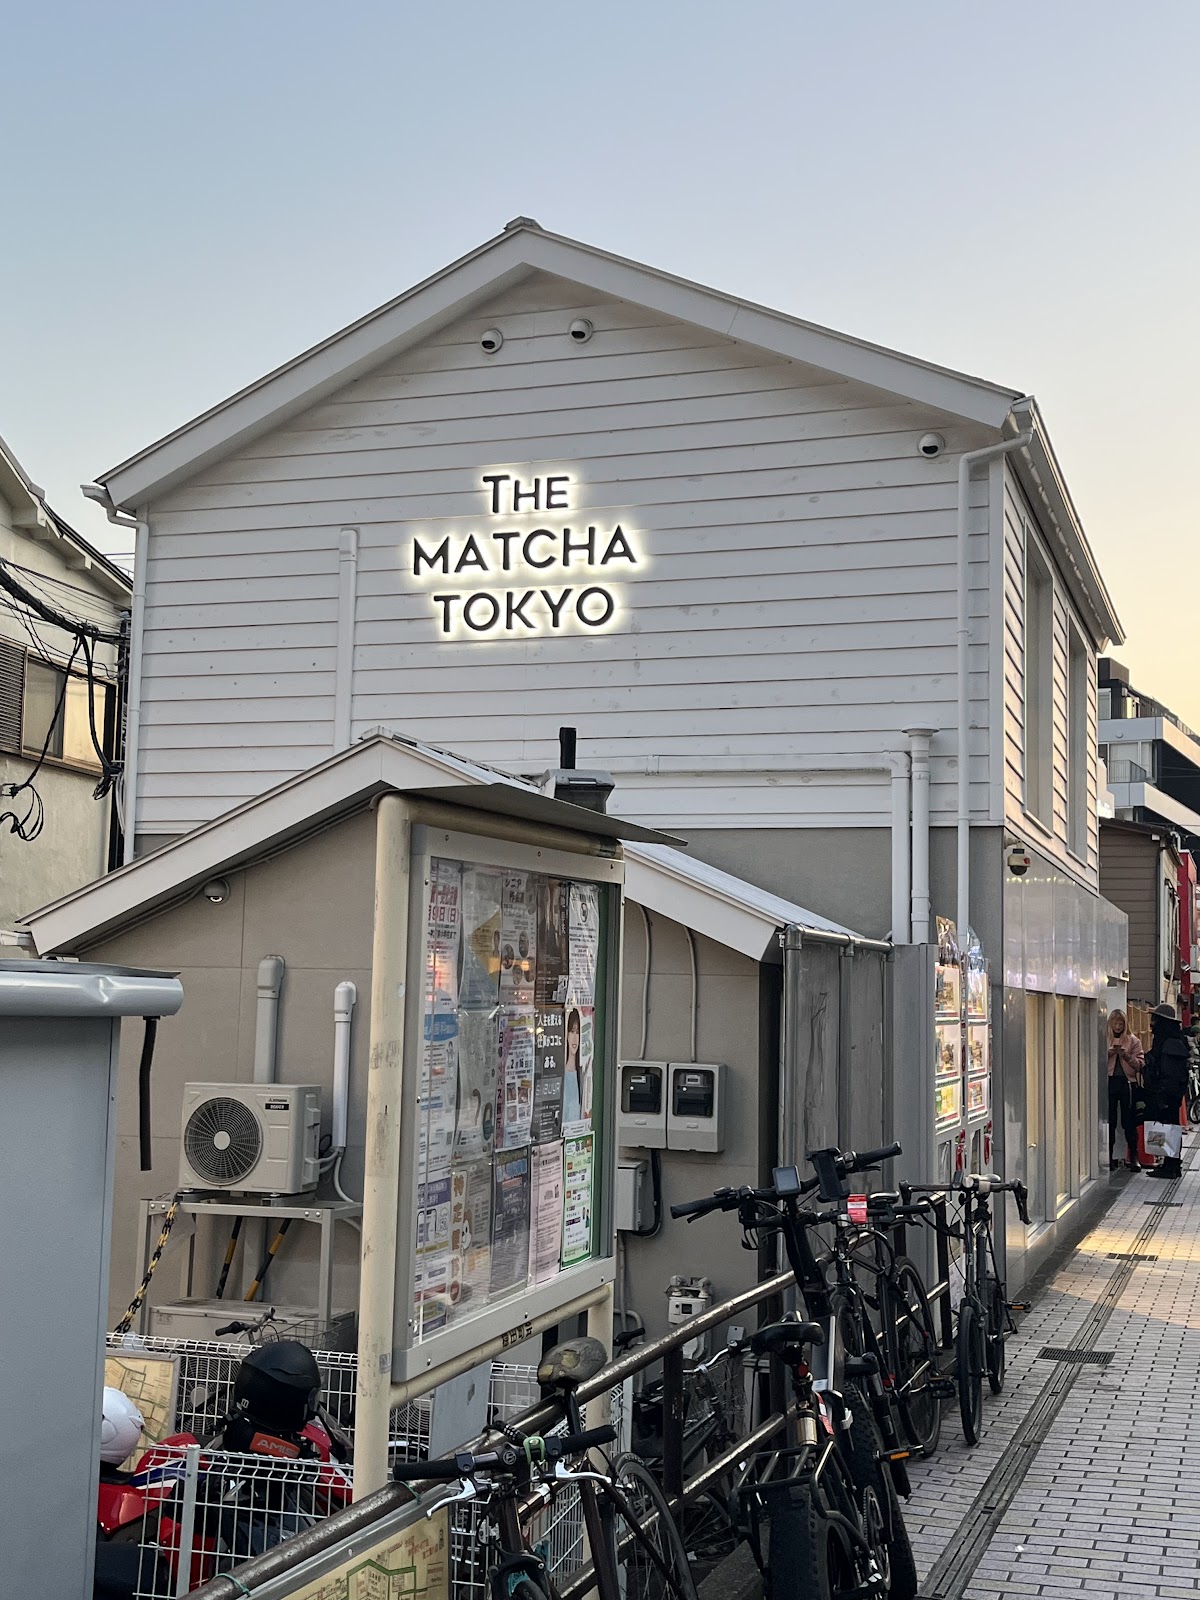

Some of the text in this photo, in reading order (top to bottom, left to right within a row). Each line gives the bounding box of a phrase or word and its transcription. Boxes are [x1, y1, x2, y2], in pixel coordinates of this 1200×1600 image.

[482, 475, 570, 513] THE
[413, 525, 638, 576] MATCHA
[433, 587, 615, 633] TOKYO
